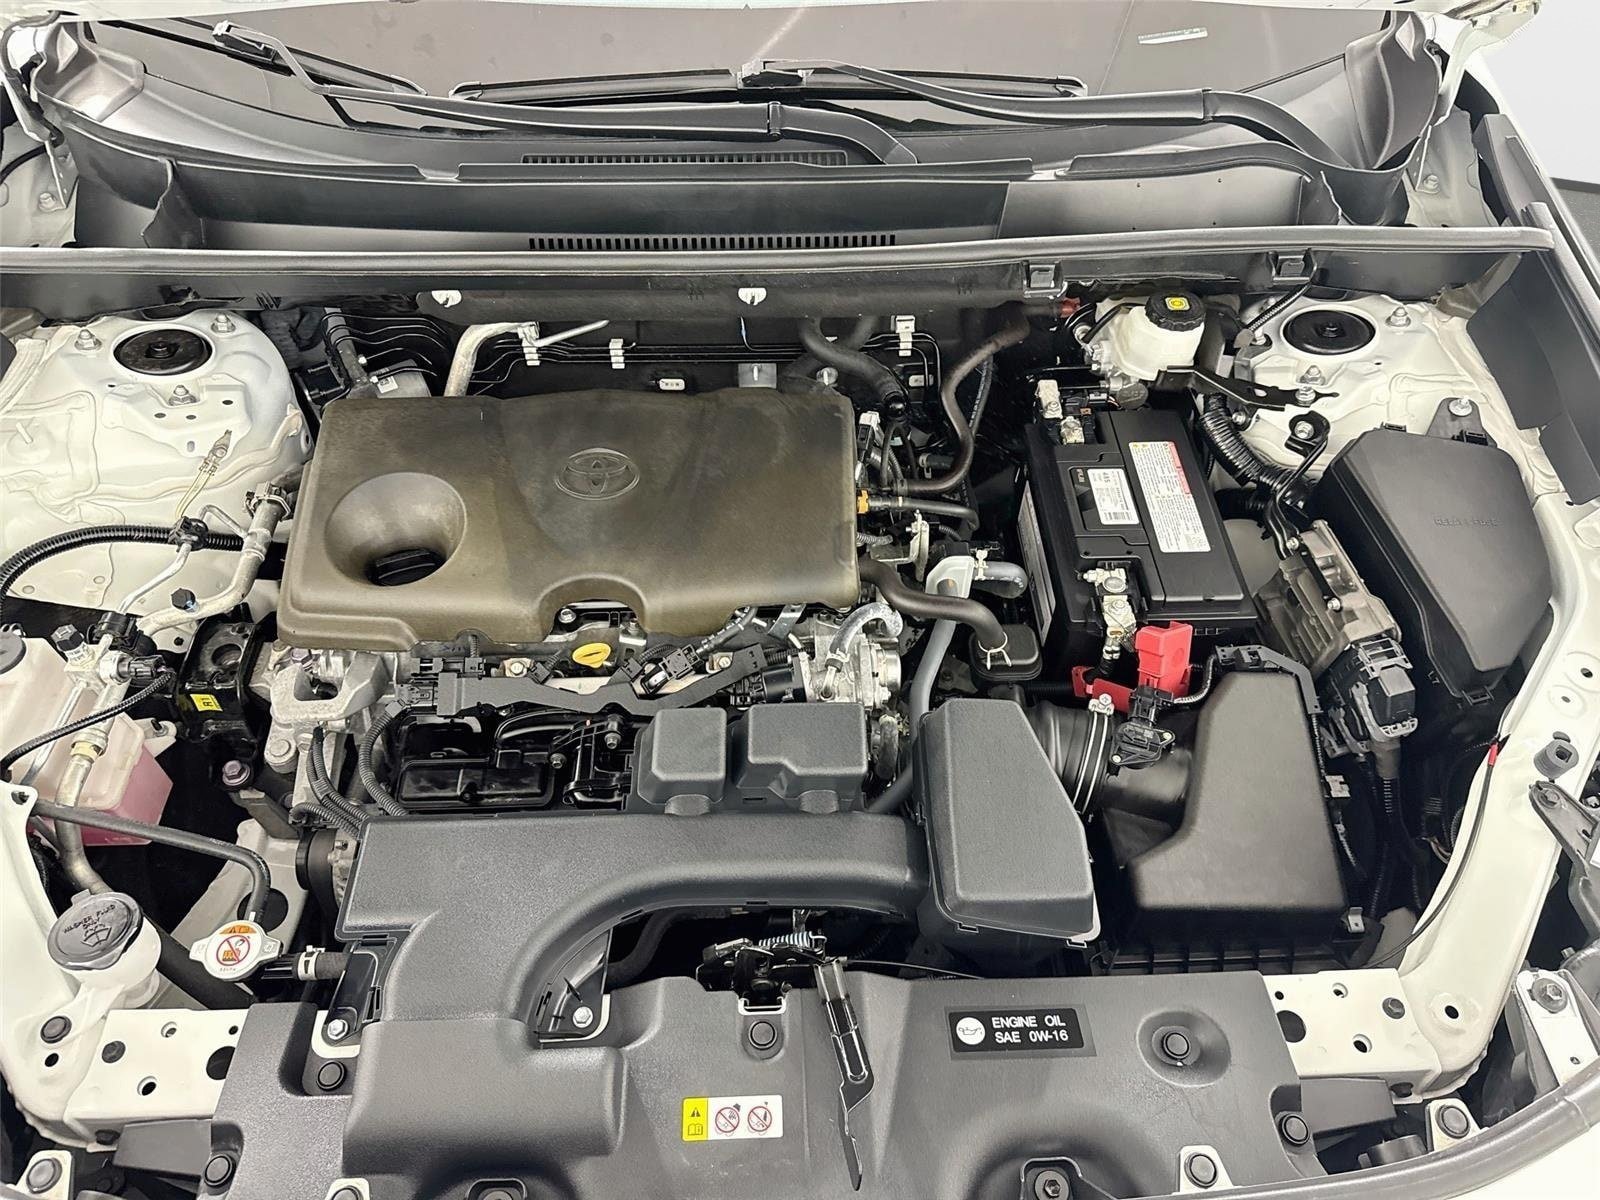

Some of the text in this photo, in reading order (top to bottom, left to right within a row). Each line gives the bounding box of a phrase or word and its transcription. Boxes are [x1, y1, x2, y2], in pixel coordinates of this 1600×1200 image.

[63, 904, 116, 934] WASHER FLUID
[82, 917, 101, 929] ONLY
[992, 1014, 1066, 1029] ENGINE OIL
[995, 1029, 1069, 1044] SAE 0W-16
